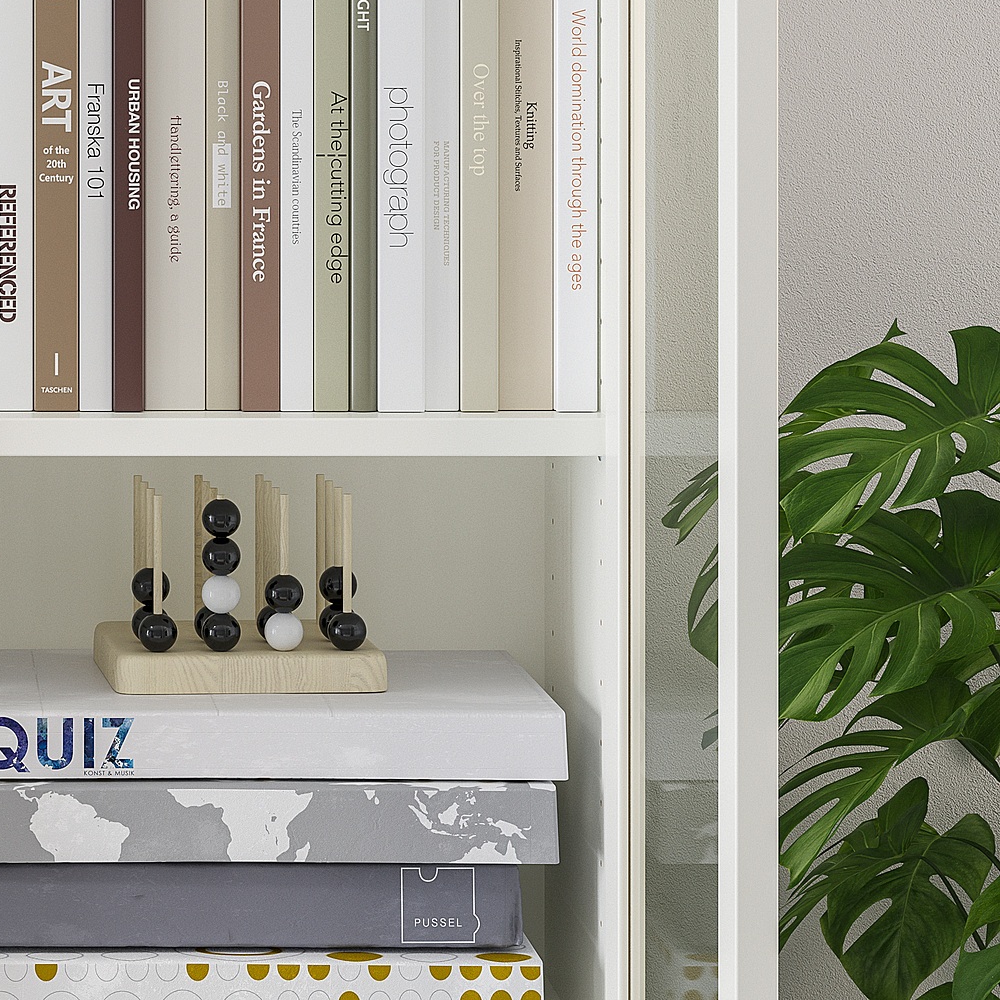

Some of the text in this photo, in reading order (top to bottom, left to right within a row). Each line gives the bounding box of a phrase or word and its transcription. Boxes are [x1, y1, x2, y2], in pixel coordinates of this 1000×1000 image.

[41, 61, 72, 132] ART
[512, 39, 522, 84] Inspirational
[512, 85, 522, 114] Stitches,
[43, 145, 70, 154] of the
[46, 159, 67, 168] 20th
[87, 83, 105, 198] Franska 101
[128, 79, 141, 210] URBAN HOUSING
[217, 80, 230, 206] Black and white
[383, 87, 414, 248] photograph
[468, 63, 490, 176] Over the top
[514, 116, 522, 146] Textures
[523, 101, 538, 150] Knitting
[567, 9, 587, 291] World domination through the ages
[39, 173, 74, 184] Century
[167, 115, 182, 263] Handlettering, a guide
[252, 80, 271, 283] Gardens in France
[291, 109, 302, 245] The Scandinavian countries
[326, 91, 349, 284] At the cutting edge
[0, 184, 17, 323] REFERENCED
[414, 917, 463, 928] PUSSEL
